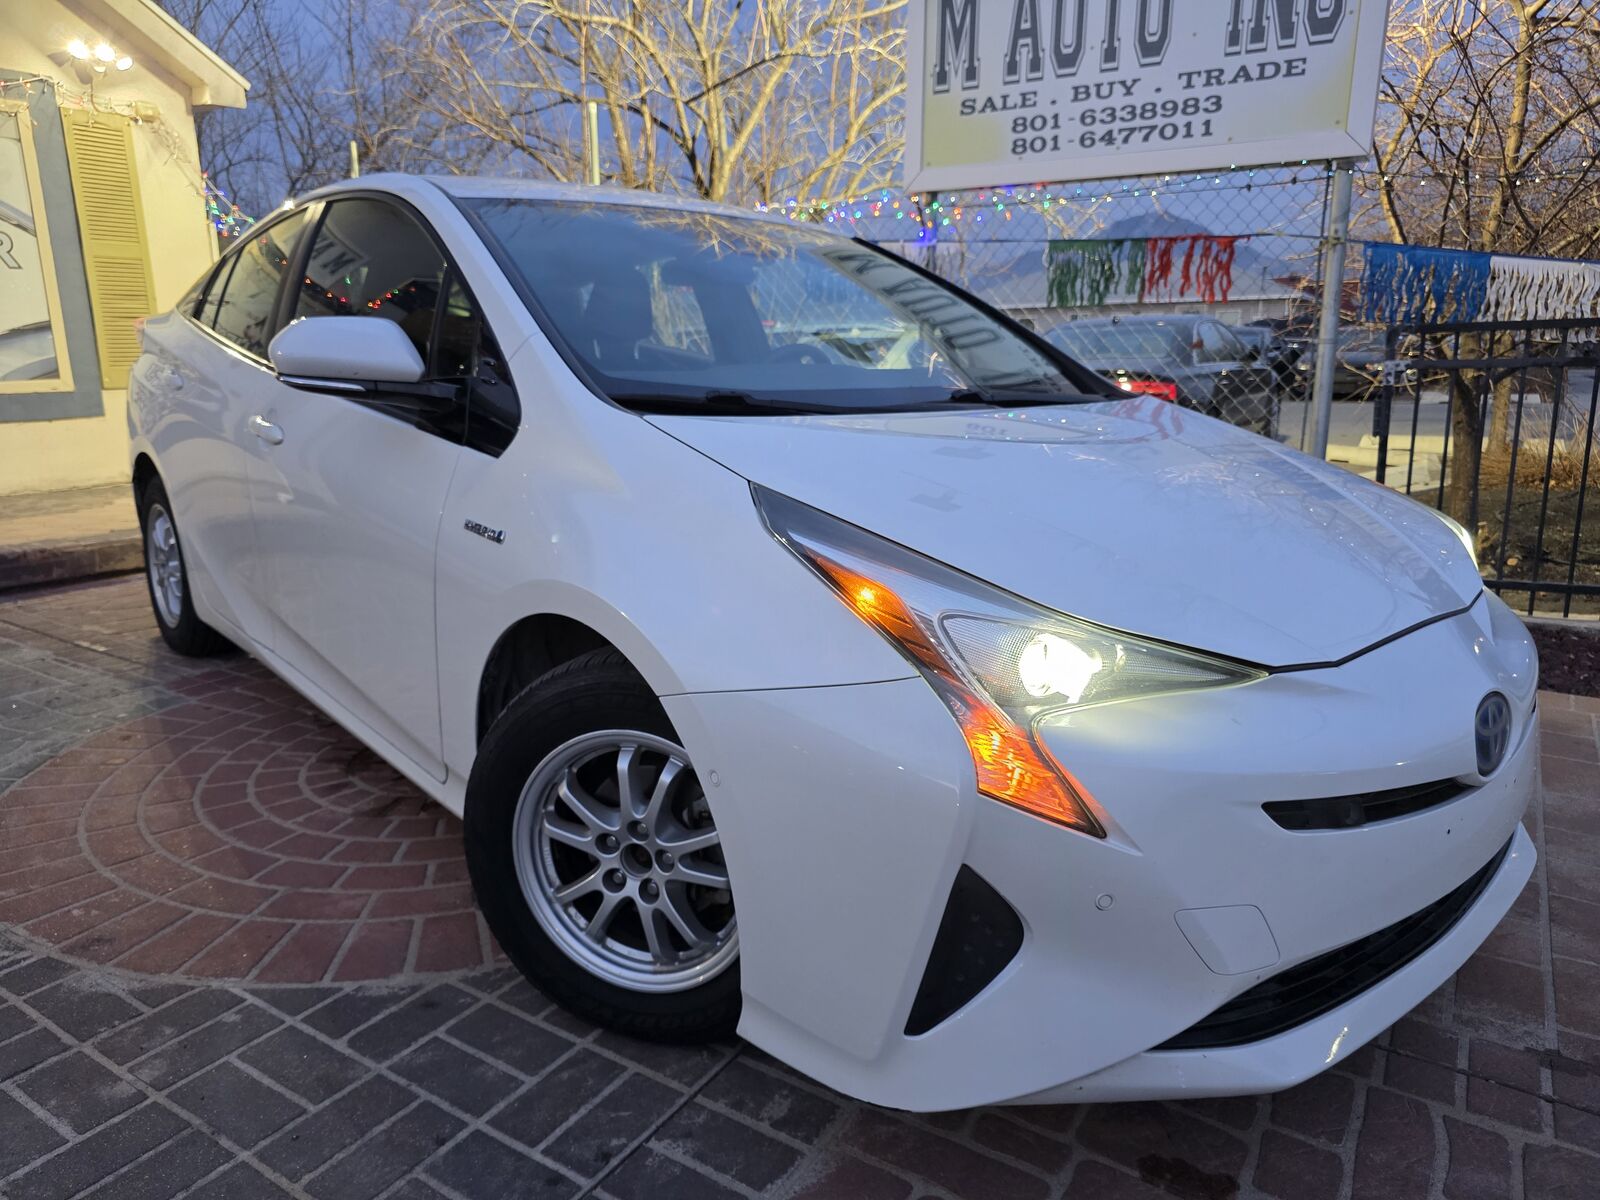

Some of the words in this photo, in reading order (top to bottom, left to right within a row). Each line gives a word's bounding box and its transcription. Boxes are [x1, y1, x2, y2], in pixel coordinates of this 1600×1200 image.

[933, 0, 981, 94] M
[1003, 0, 1174, 84] AUTO
[960, 91, 1038, 116] SALE
[1071, 78, 1141, 103] BUY
[1178, 58, 1307, 90] TRADE
[1011, 95, 1223, 133] 801-6338983
[1011, 120, 1214, 155] 801-6477011
